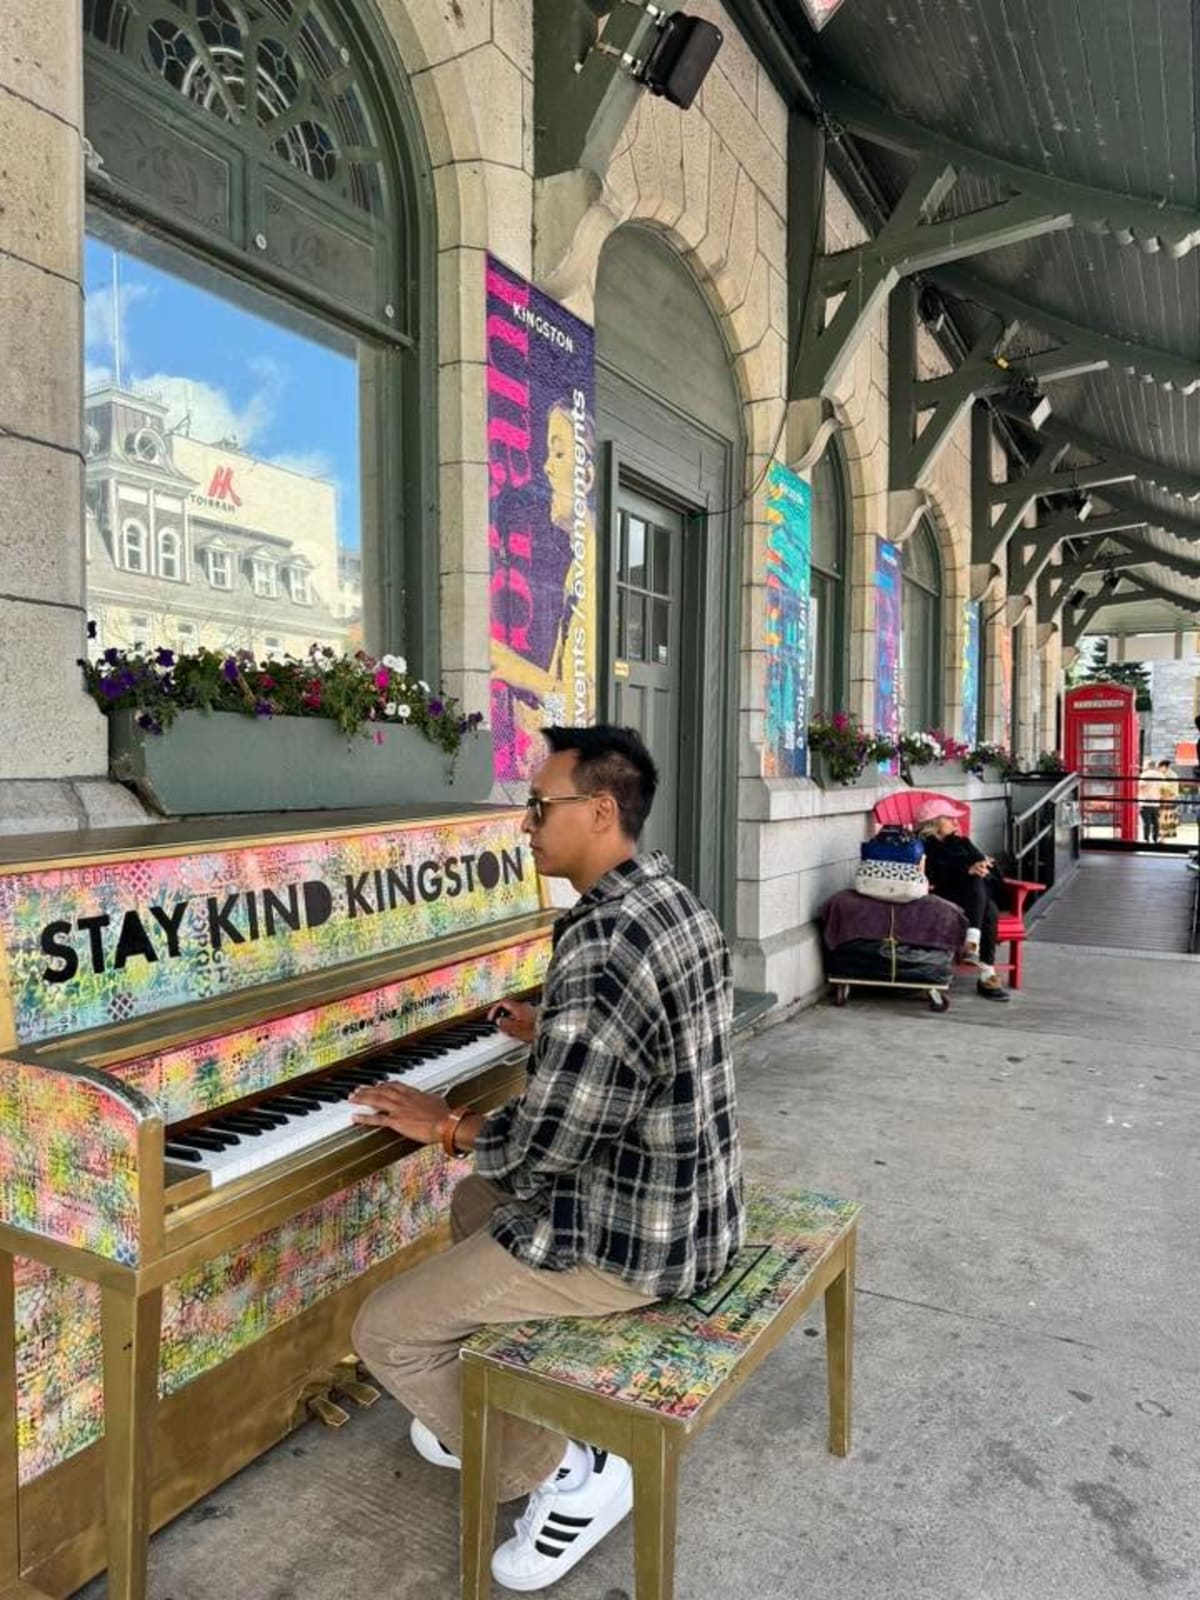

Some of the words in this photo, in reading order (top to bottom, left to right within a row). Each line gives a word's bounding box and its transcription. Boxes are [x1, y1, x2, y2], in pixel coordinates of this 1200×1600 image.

[512, 301, 574, 354] KINGSTON
[571, 388, 588, 599] événements
[41, 901, 189, 984] STAY
[208, 880, 333, 949] KIND
[345, 846, 524, 918] KINGSTON
